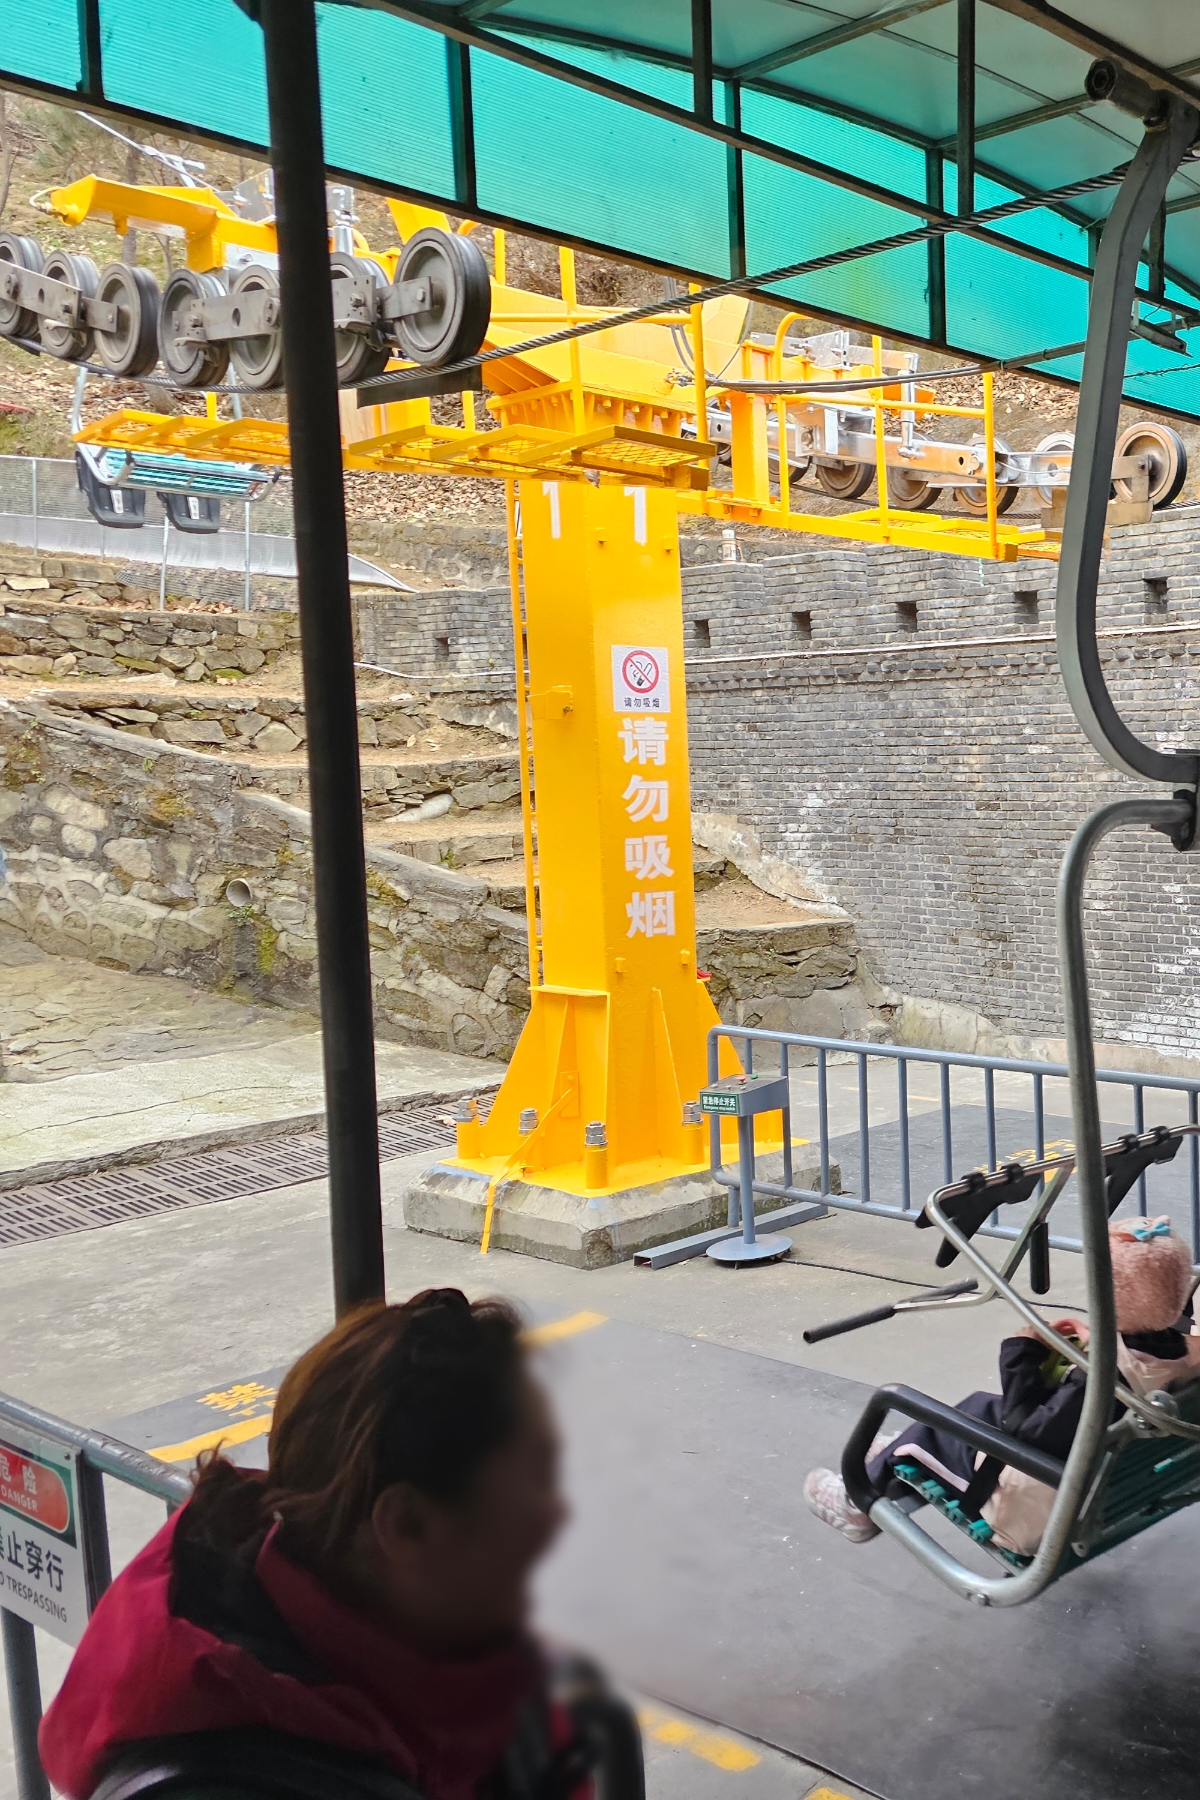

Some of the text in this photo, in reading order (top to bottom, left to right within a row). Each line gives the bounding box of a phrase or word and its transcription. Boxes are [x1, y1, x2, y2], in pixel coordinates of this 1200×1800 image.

[624, 485, 647, 546] 1
[624, 696, 661, 709] 请勿吸烟
[617, 716, 675, 938] 请勿吸烟
[1, 1485, 38, 1513] DANGER
[6, 1573, 68, 1624] TRESPASSING
